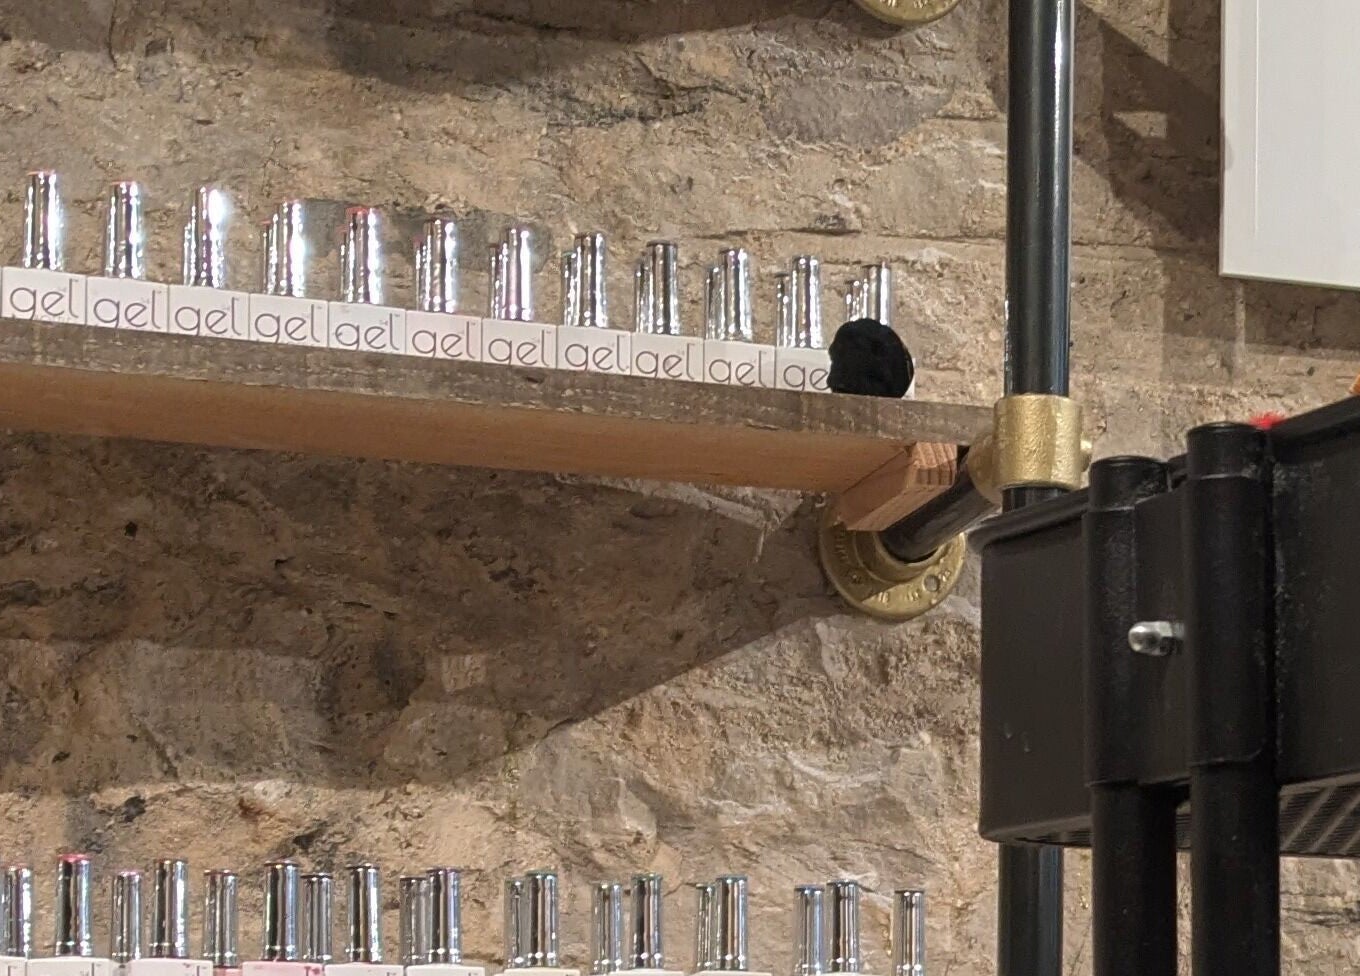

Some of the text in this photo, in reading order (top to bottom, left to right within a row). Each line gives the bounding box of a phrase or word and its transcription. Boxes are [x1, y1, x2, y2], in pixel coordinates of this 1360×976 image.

[10, 279, 79, 319] gel
[94, 289, 161, 328] gel
[175, 296, 242, 335] gel
[255, 304, 320, 343] gel
[336, 313, 399, 350] gel
[412, 321, 475, 358] gel
[488, 329, 549, 366] gel
[565, 335, 626, 371] gel
[636, 343, 695, 379] gel
[709, 350, 767, 387] gel
[783, 365, 829, 391] ge
